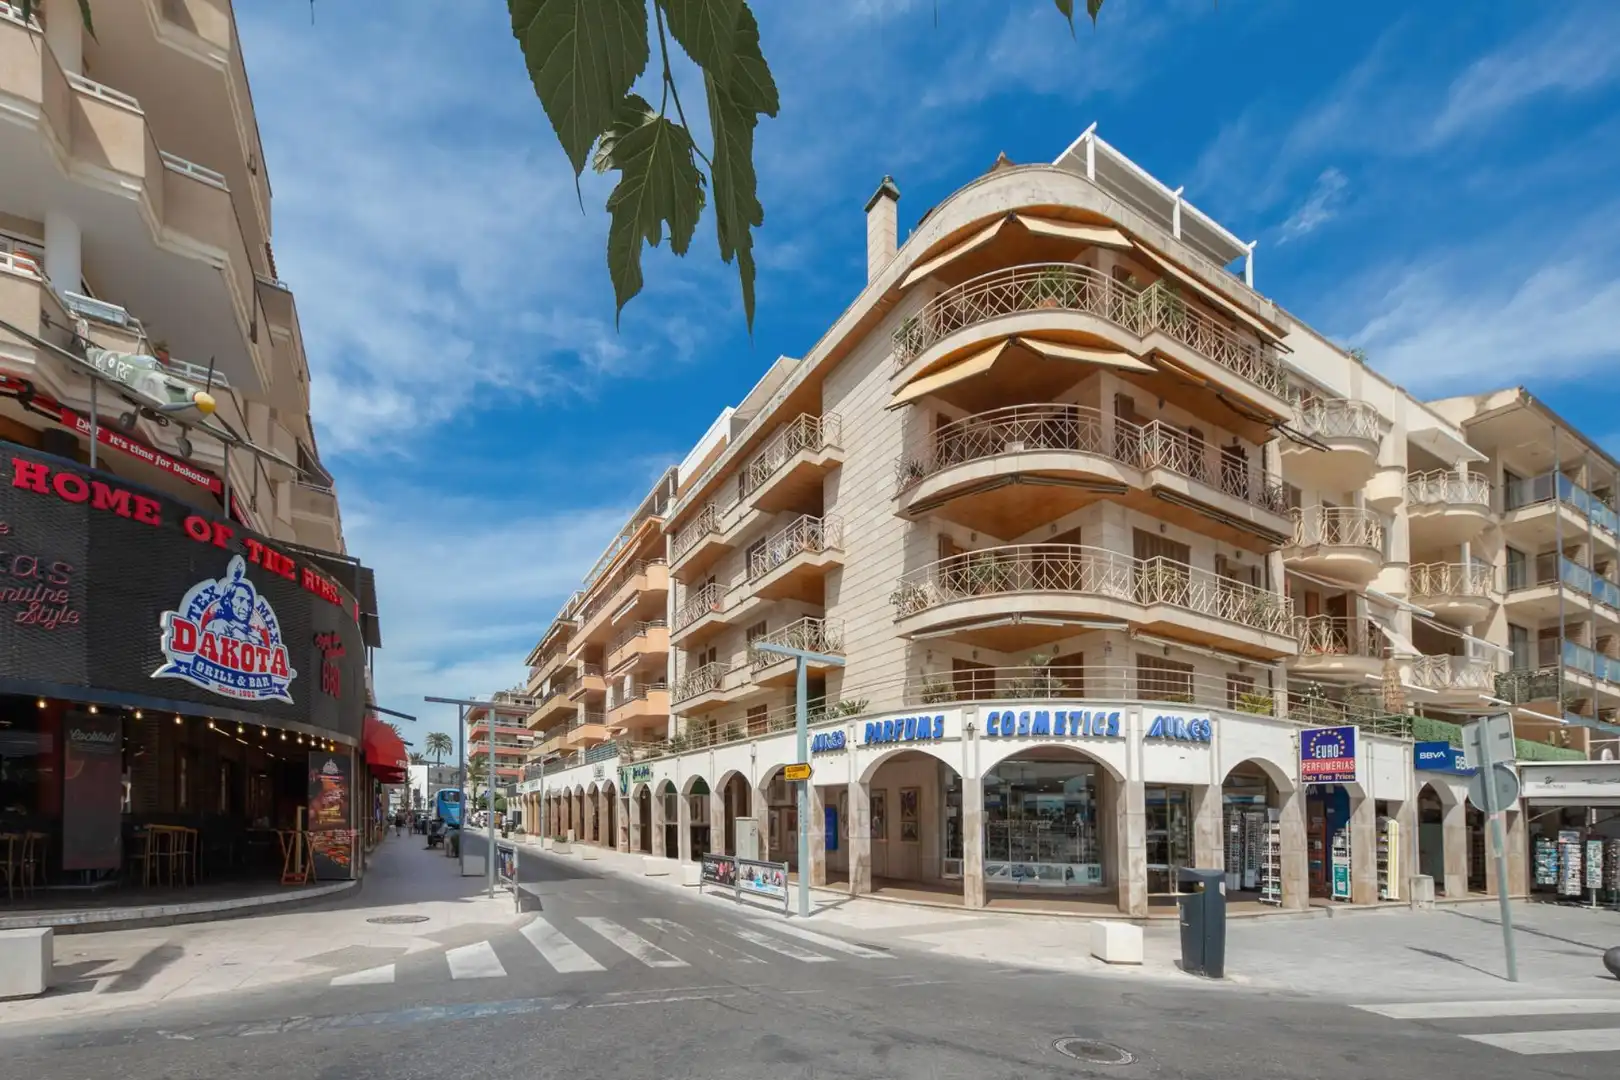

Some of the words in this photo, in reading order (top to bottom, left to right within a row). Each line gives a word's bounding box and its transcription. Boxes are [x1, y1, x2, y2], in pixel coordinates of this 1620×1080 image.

[109, 435, 128, 449] It's
[130, 443, 153, 461] time
[155, 455, 171, 468] for
[11, 457, 161, 526] HOME
[184, 515, 235, 549] OF
[242, 537, 296, 581] THE
[0, 552, 74, 584] as
[0, 584, 69, 604] nuine
[187, 585, 220, 621] TEX
[15, 600, 80, 630] Style
[257, 602, 280, 645] MEX
[171, 616, 289, 677] DAKOTA
[195, 661, 234, 684] GRILL
[236, 675, 246, 687] &
[248, 676, 270, 688] BAR
[864, 715, 945, 745] PARFUMS
[986, 710, 1121, 737] COSMETICS
[1147, 715, 1212, 742] AURES
[1302, 760, 1355, 772] PERFUMERIAS
[1316, 744, 1339, 758] EURO
[1419, 751, 1446, 760] BBVA
